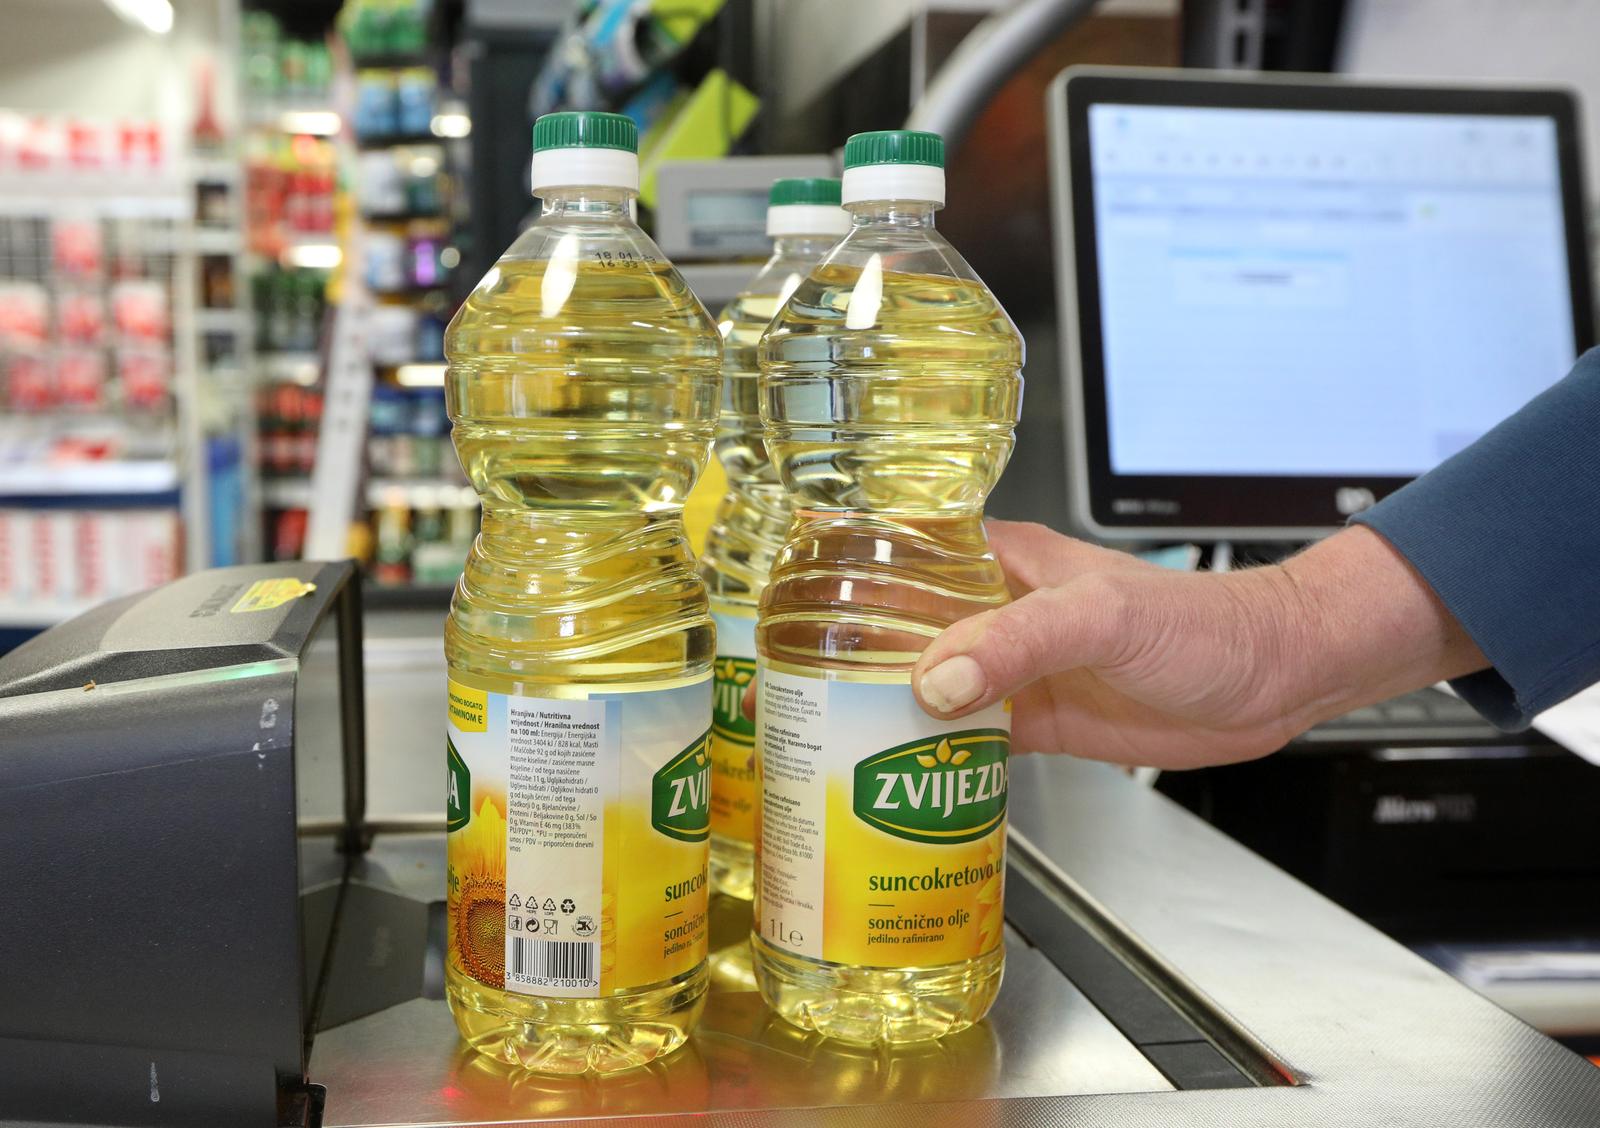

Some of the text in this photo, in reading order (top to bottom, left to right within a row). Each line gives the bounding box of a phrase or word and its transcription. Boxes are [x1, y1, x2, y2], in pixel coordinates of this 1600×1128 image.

[596, 252, 612, 260] 18
[619, 252, 632, 260] 01
[464, 700, 482, 710] BOGATO
[510, 709, 534, 718] Hranjiva
[478, 714, 483, 724] E
[511, 719, 539, 727] vrijednost
[541, 731, 563, 739] Energija
[807, 742, 822, 751] bogat
[869, 862, 993, 891] suncokretovo
[868, 909, 970, 930] sončnično olje
[868, 933, 944, 945] jedilno rafinirano
[516, 974, 549, 985] 858882
